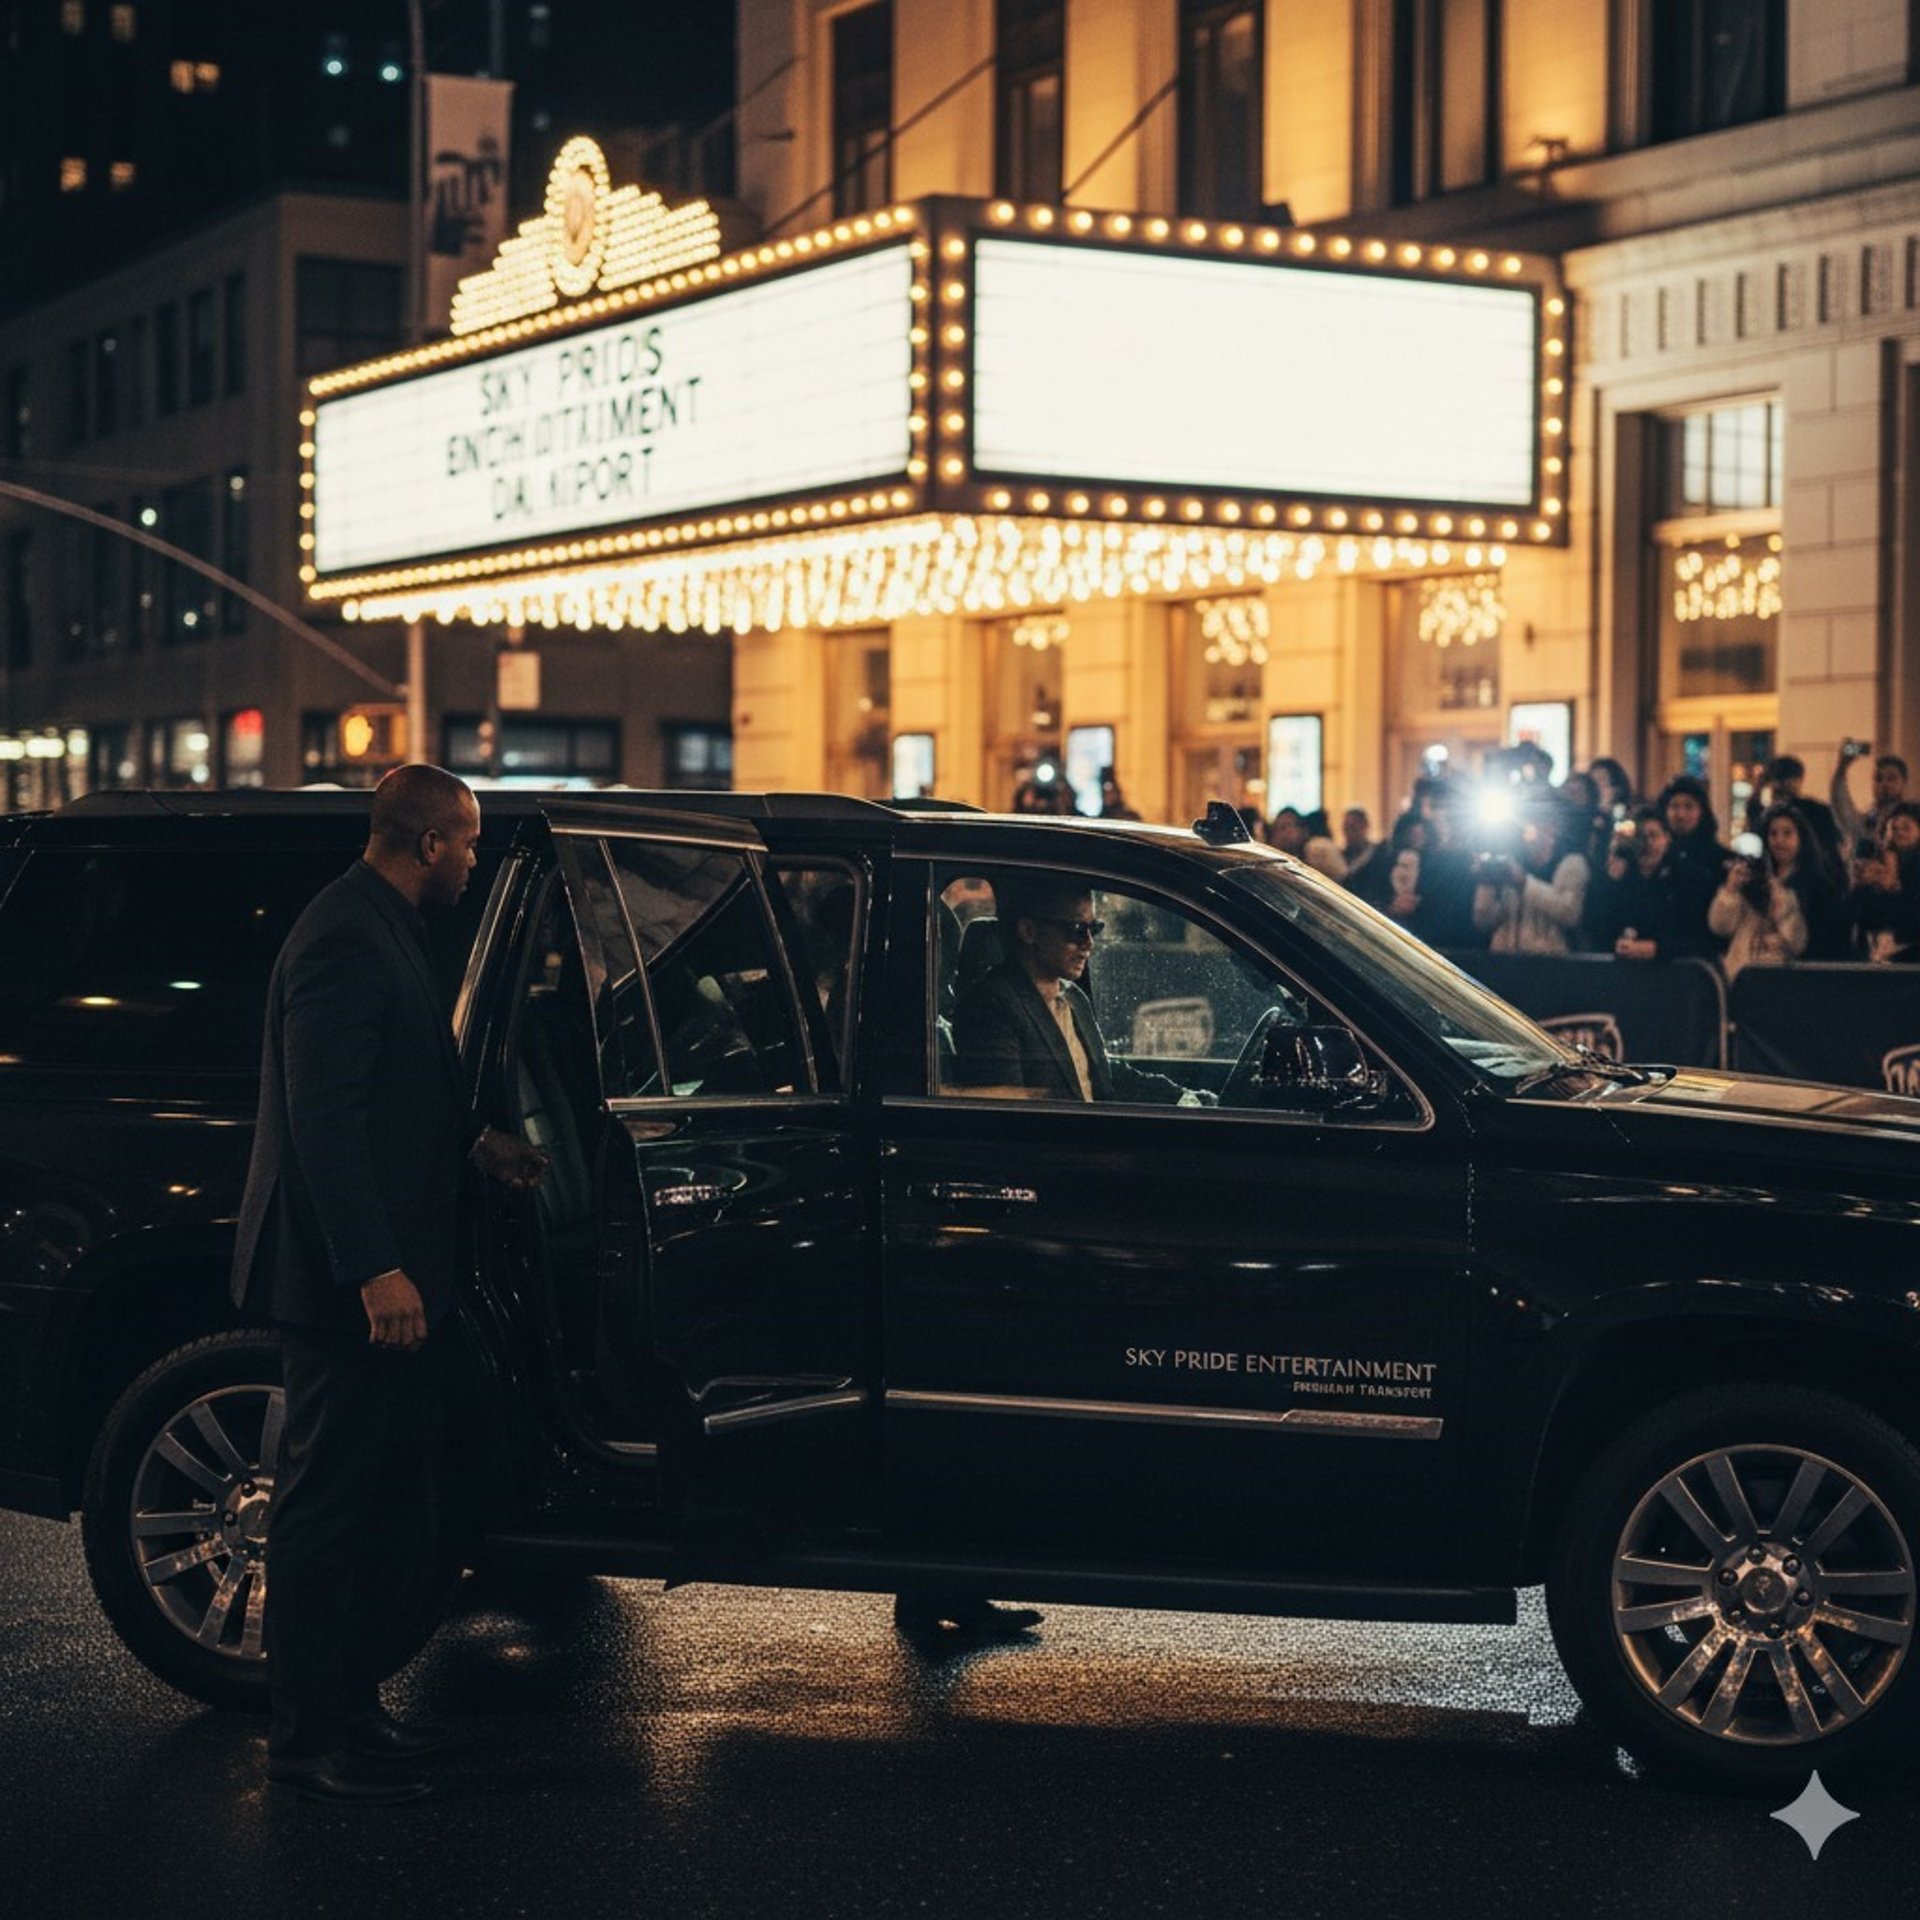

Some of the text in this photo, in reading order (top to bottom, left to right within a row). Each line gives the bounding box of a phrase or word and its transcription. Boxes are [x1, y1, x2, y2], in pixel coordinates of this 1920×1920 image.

[1125, 1348, 1437, 1382] SKY PRIDE ENTERTAINMENT
